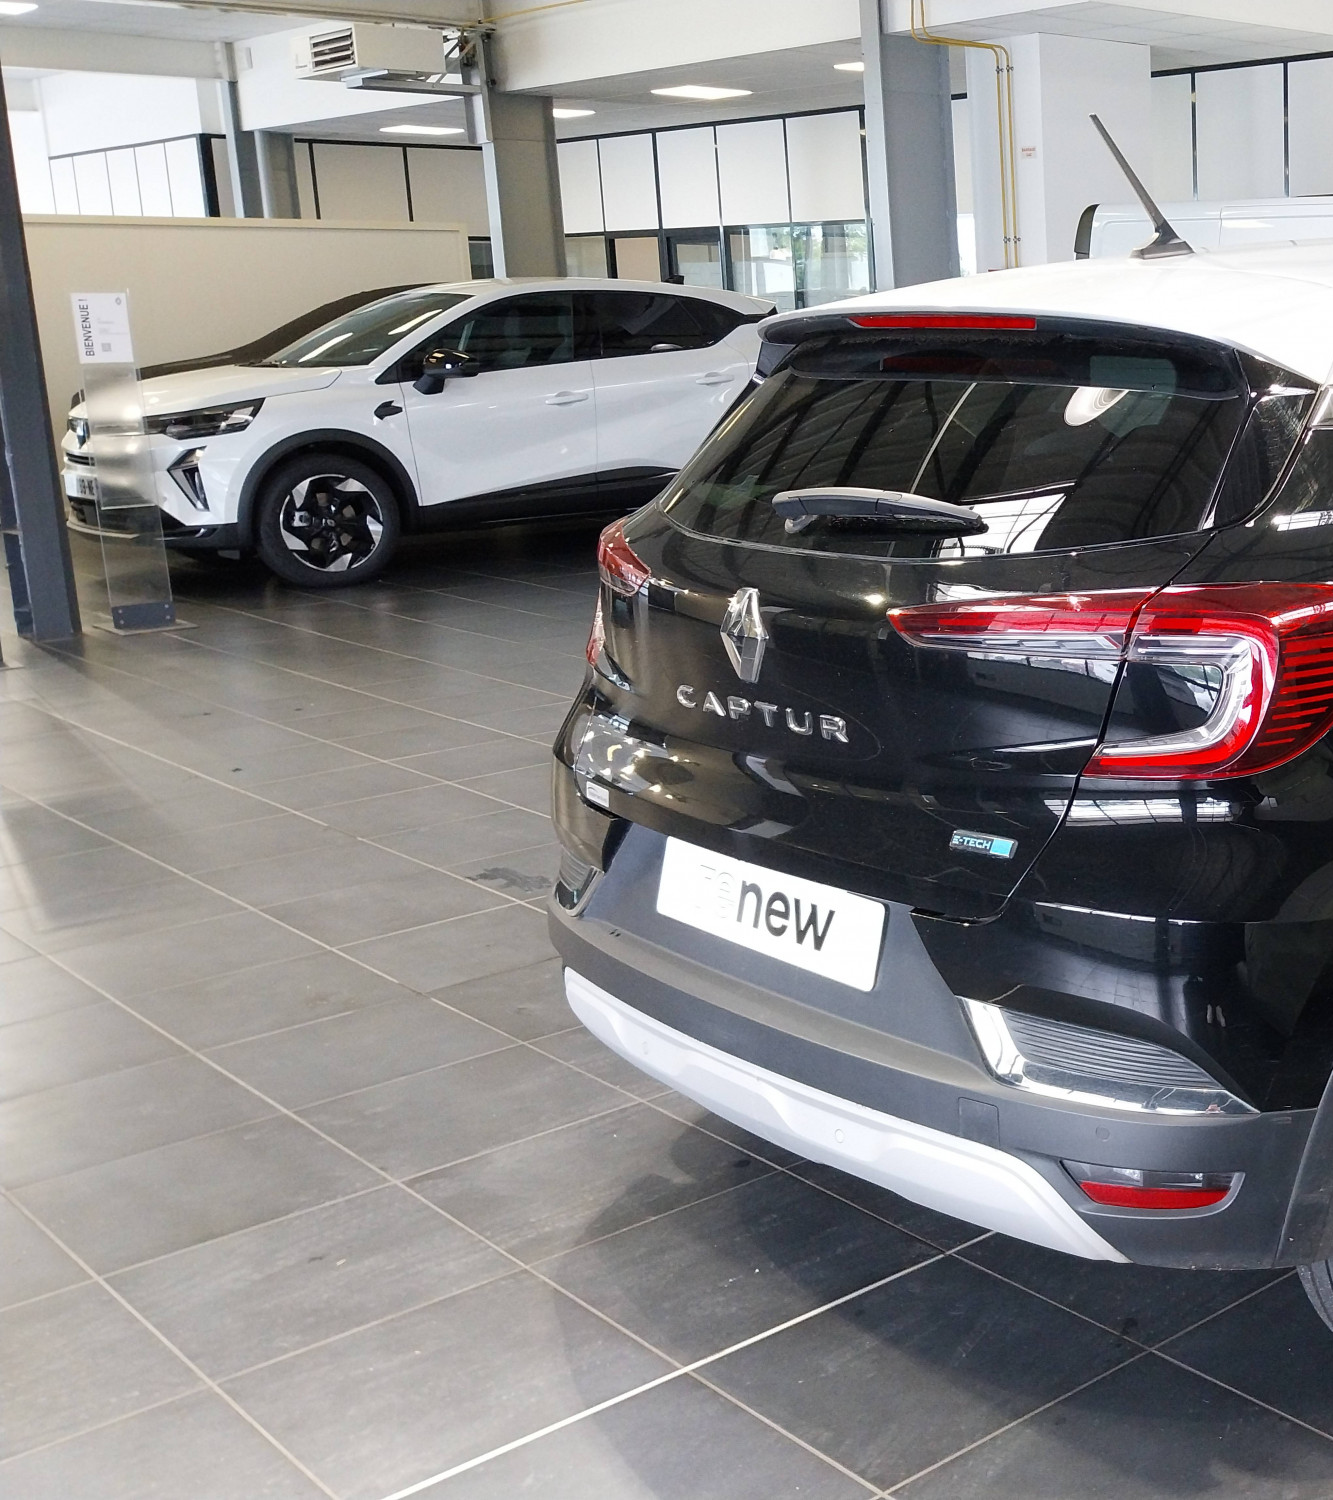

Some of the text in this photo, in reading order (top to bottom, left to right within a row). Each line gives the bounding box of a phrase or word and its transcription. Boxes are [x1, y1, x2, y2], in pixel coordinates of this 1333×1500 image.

[78, 303, 96, 357] BIENVENUE
[676, 684, 850, 744] CAPTUR
[952, 834, 992, 850] E-TECH
